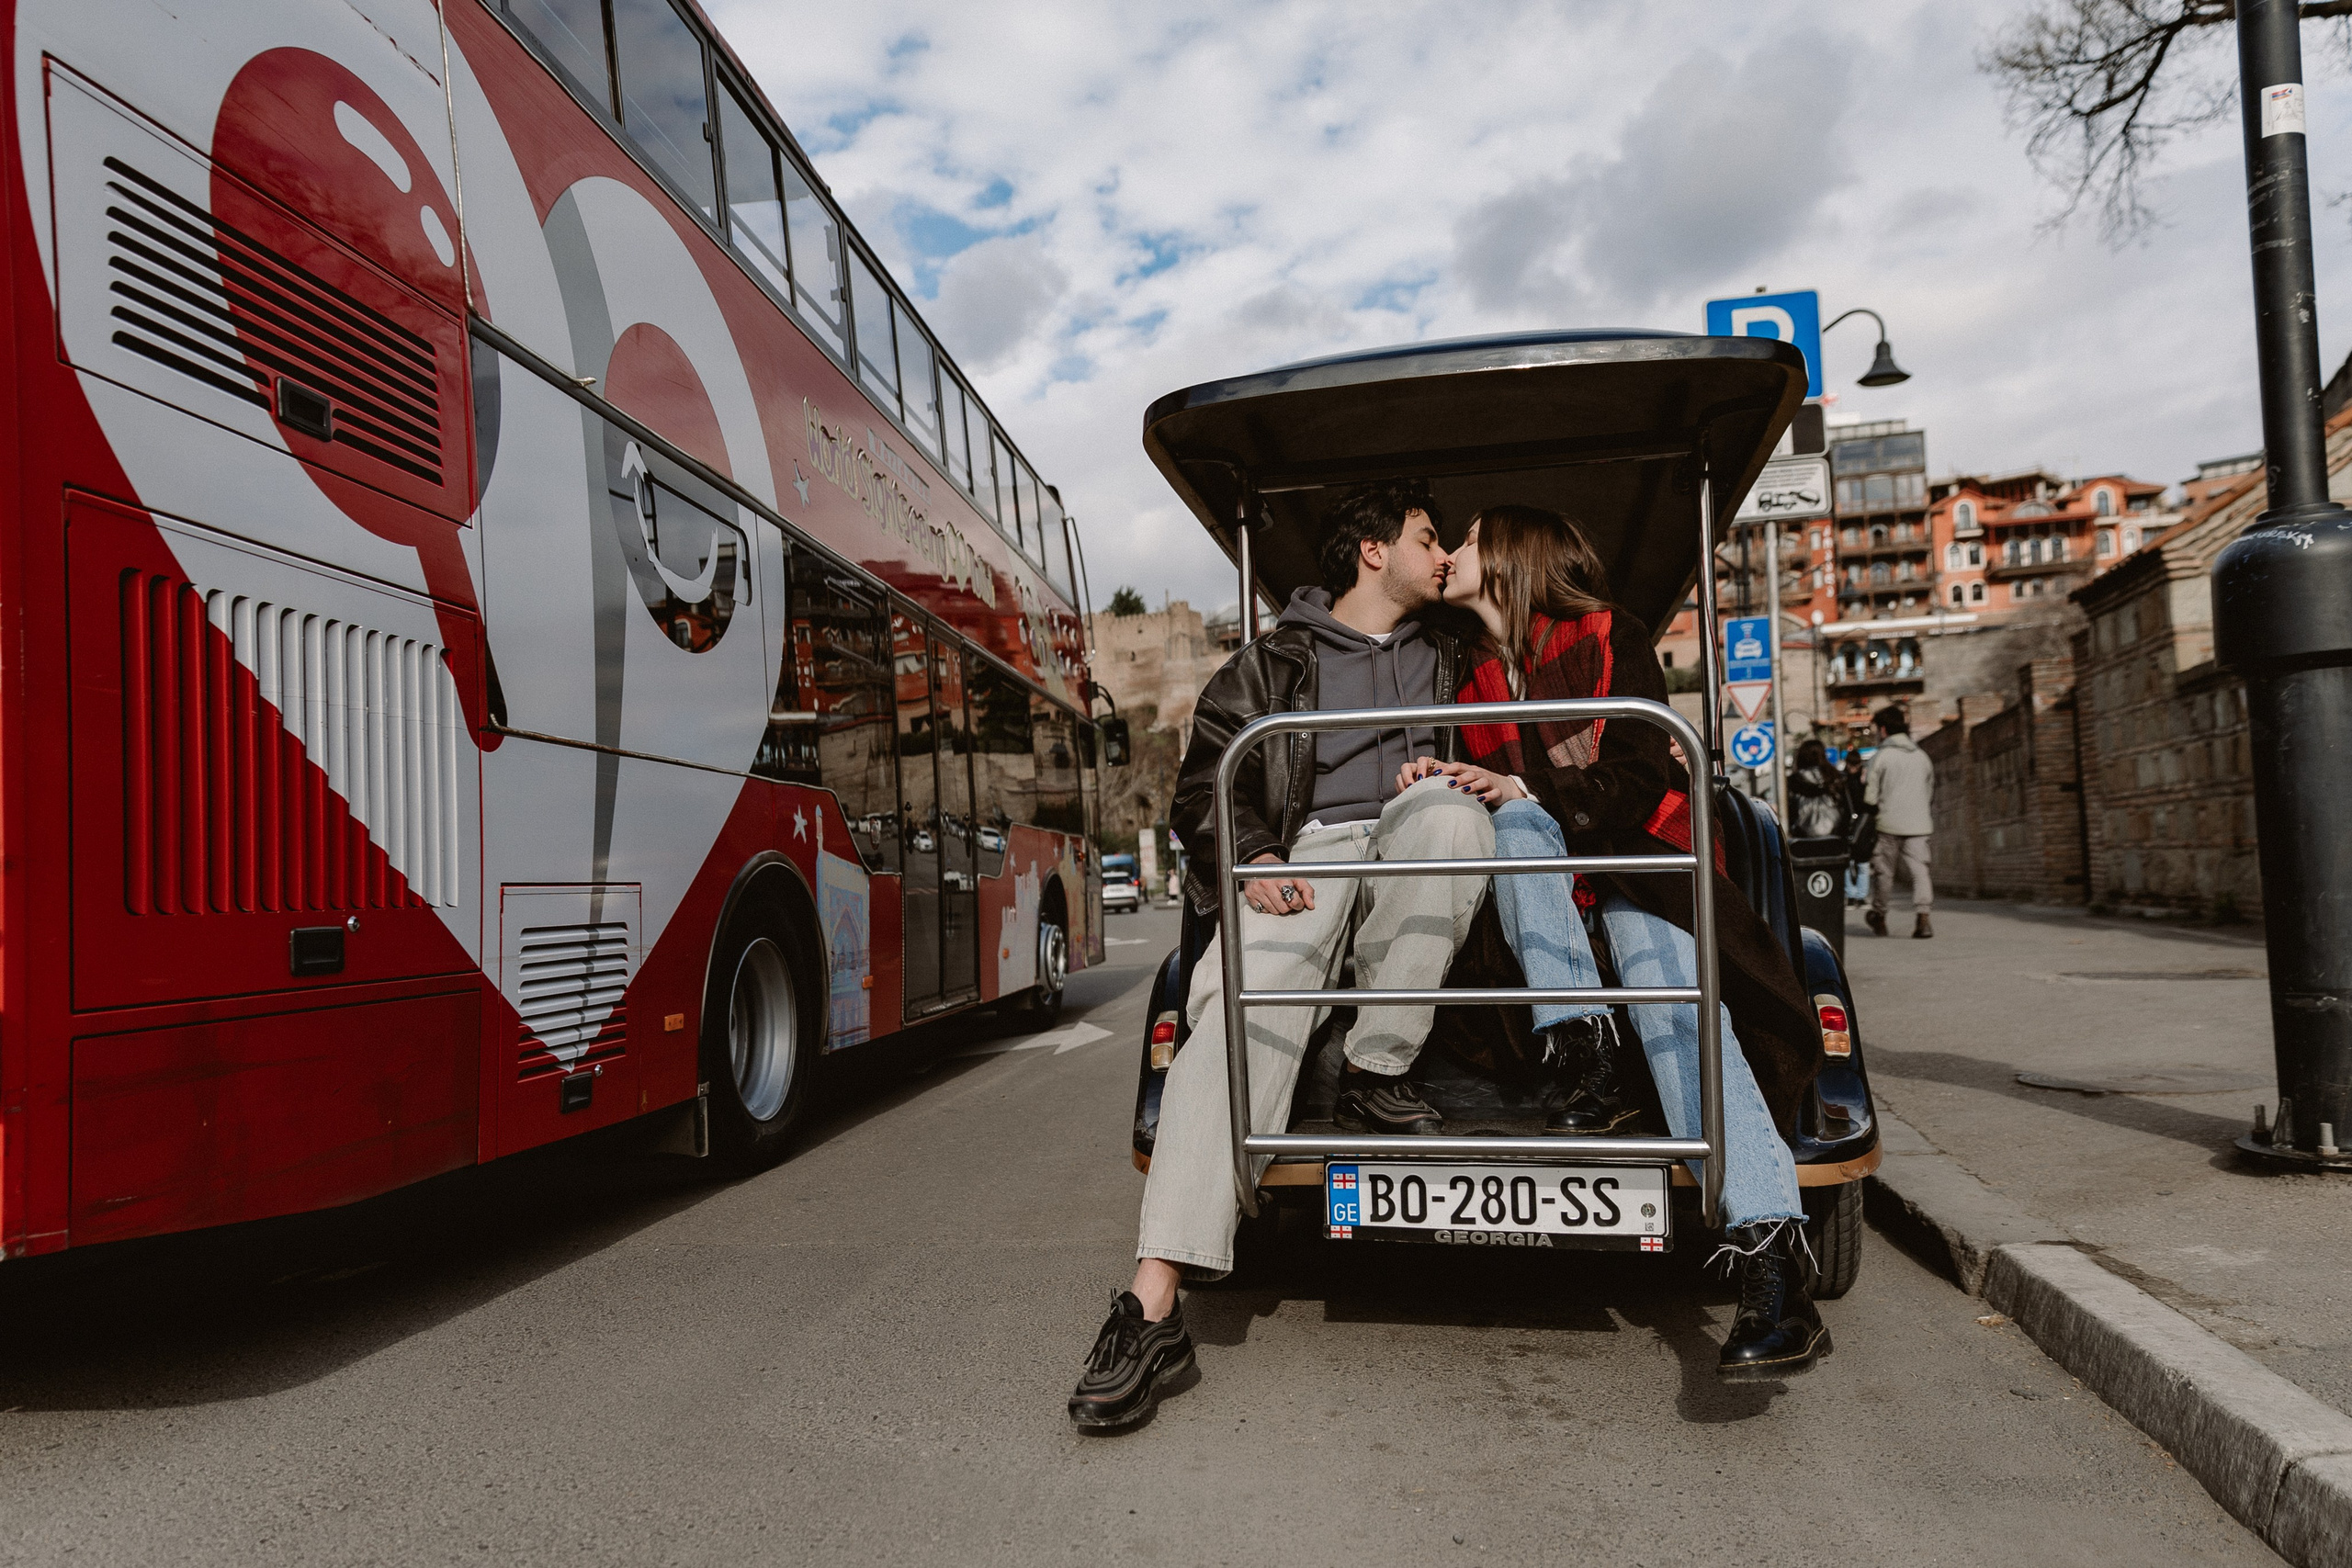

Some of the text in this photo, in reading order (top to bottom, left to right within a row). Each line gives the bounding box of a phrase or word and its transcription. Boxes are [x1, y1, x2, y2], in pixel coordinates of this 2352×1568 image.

[803, 395, 859, 501] World
[857, 448, 949, 583] Sightseeing
[1333, 1202, 1358, 1222] GE
[1368, 1174, 1621, 1227] BO-280-SS
[1434, 1230, 1554, 1247] GEORGIA
